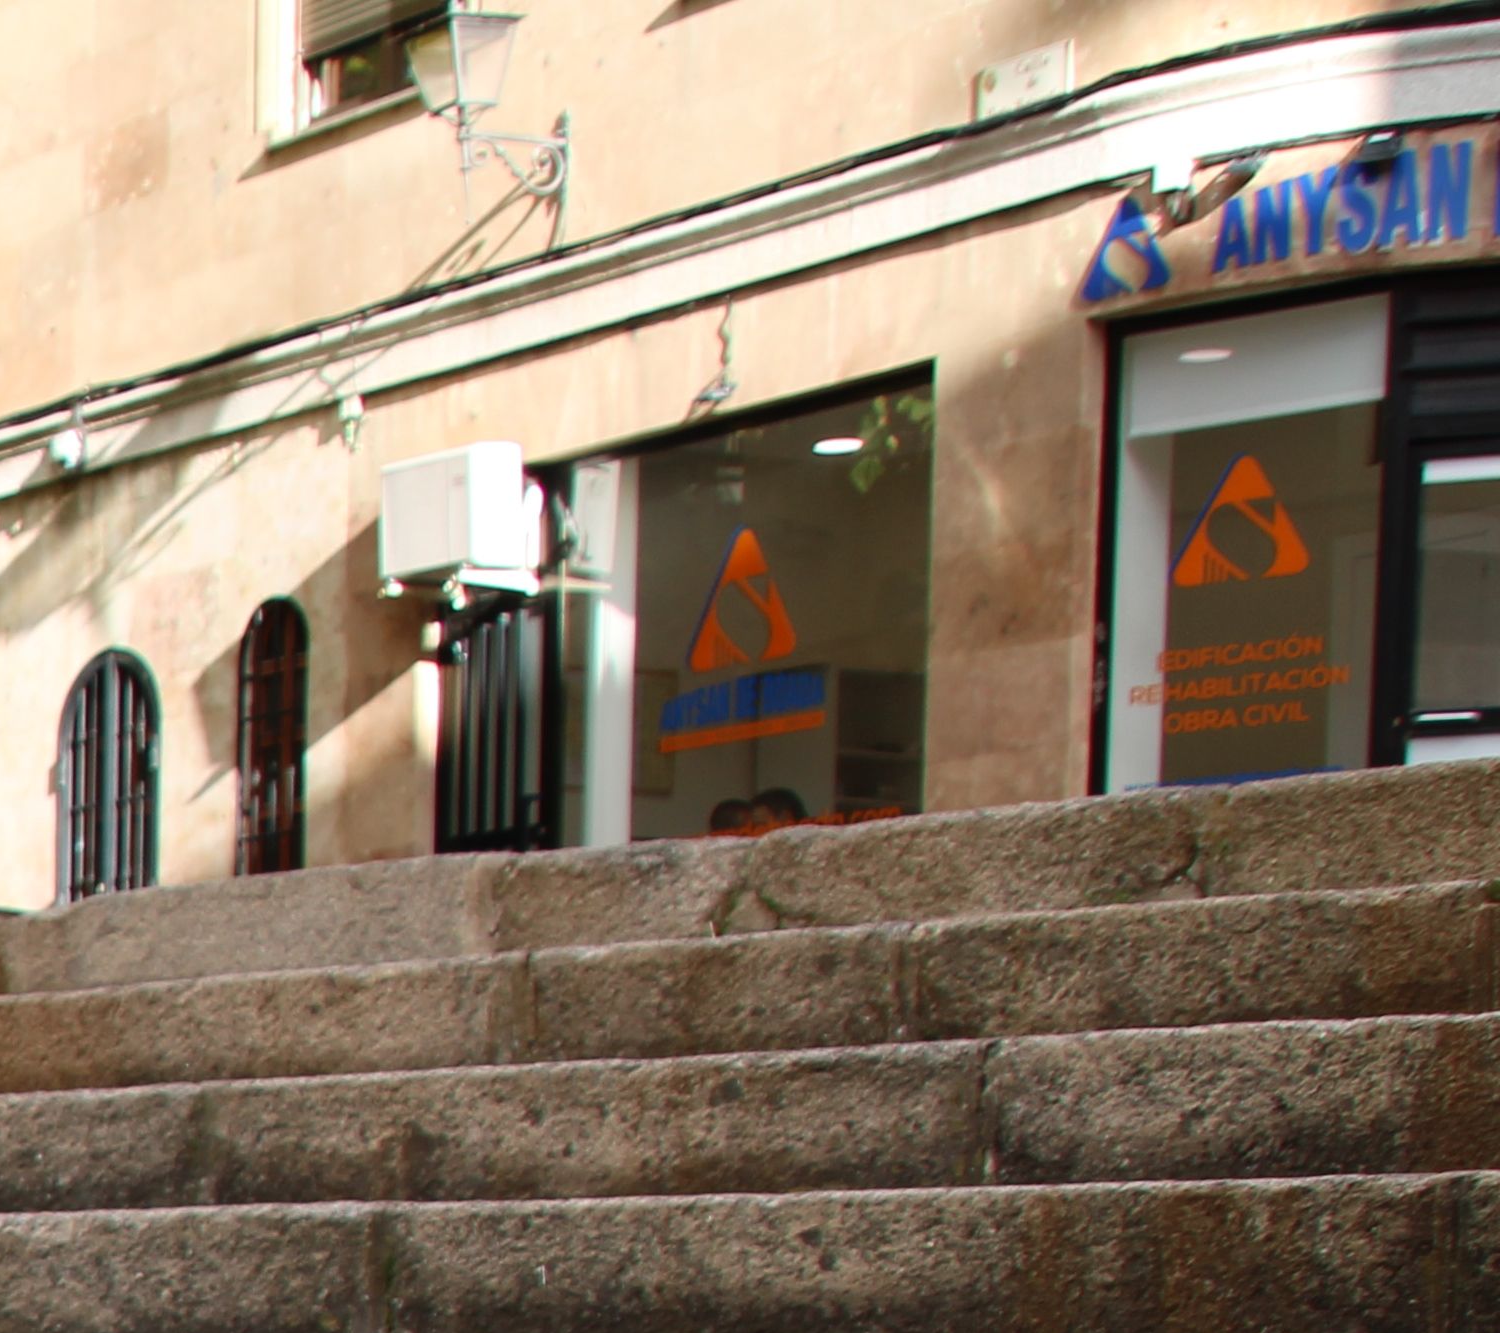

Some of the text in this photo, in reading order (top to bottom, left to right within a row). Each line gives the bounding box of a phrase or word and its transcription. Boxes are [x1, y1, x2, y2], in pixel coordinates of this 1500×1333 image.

[1211, 140, 1475, 274] ANYSAN
[1158, 633, 1325, 673] EDIFICACIÓN
[1129, 662, 1351, 706] REHABILITACIÓN
[1164, 700, 1310, 735] OBRA CIVIL
